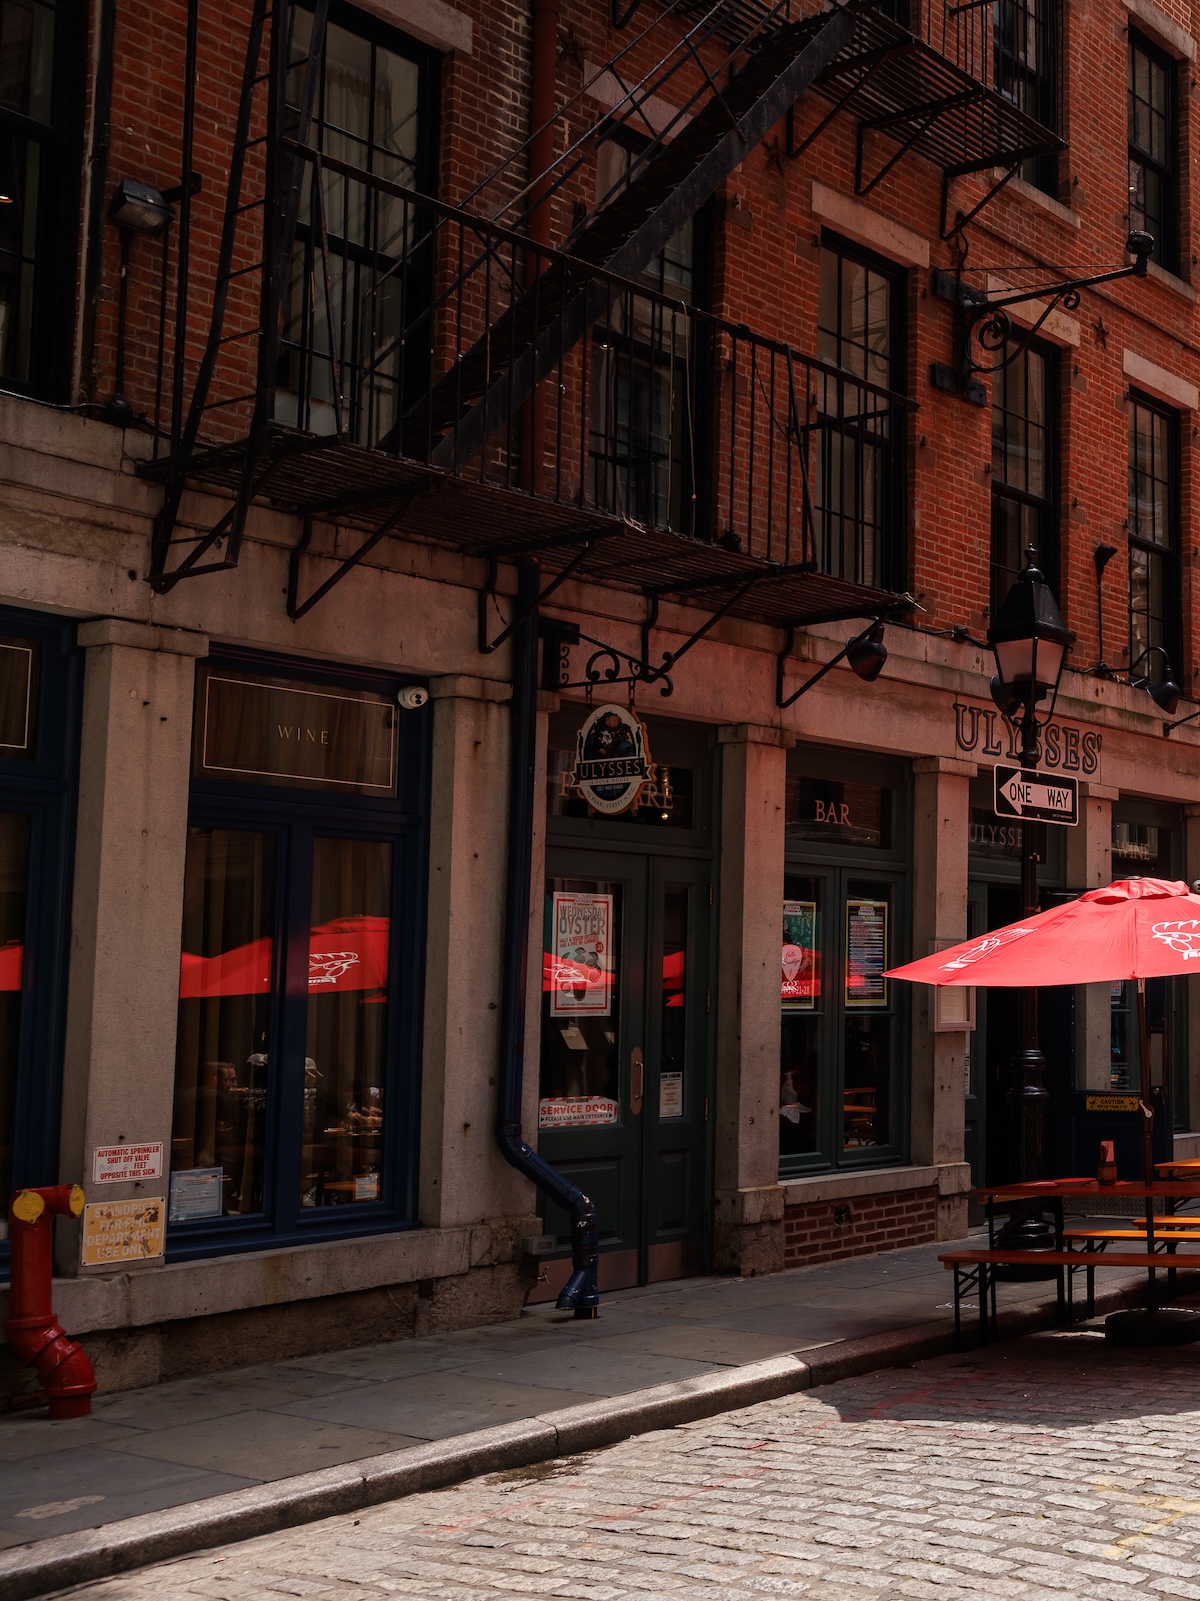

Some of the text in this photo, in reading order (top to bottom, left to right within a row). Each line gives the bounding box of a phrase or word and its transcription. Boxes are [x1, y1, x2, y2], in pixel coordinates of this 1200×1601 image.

[277, 724, 331, 746] WINE
[1009, 782, 1070, 809] ONE WAY
[814, 799, 853, 827] BAR
[968, 823, 1023, 848] ULYSSE
[1115, 840, 1150, 861] WINE
[559, 905, 607, 919] WEDNESDAY
[559, 915, 606, 936] OYSTER
[540, 1103, 614, 1116] SERVICE DOOR
[545, 1114, 562, 1122] PLEASE
[572, 1113, 585, 1121] MAIN
[97, 1146, 160, 1158] AUTOMATIC SPRINKLER
[107, 1153, 151, 1165] SHUT OFF VALVE
[100, 1166, 156, 1180] OPPOSITE THIS SIGN
[133, 1161, 147, 1170] FEET
[87, 1227, 161, 1247] DEPARTMENT
